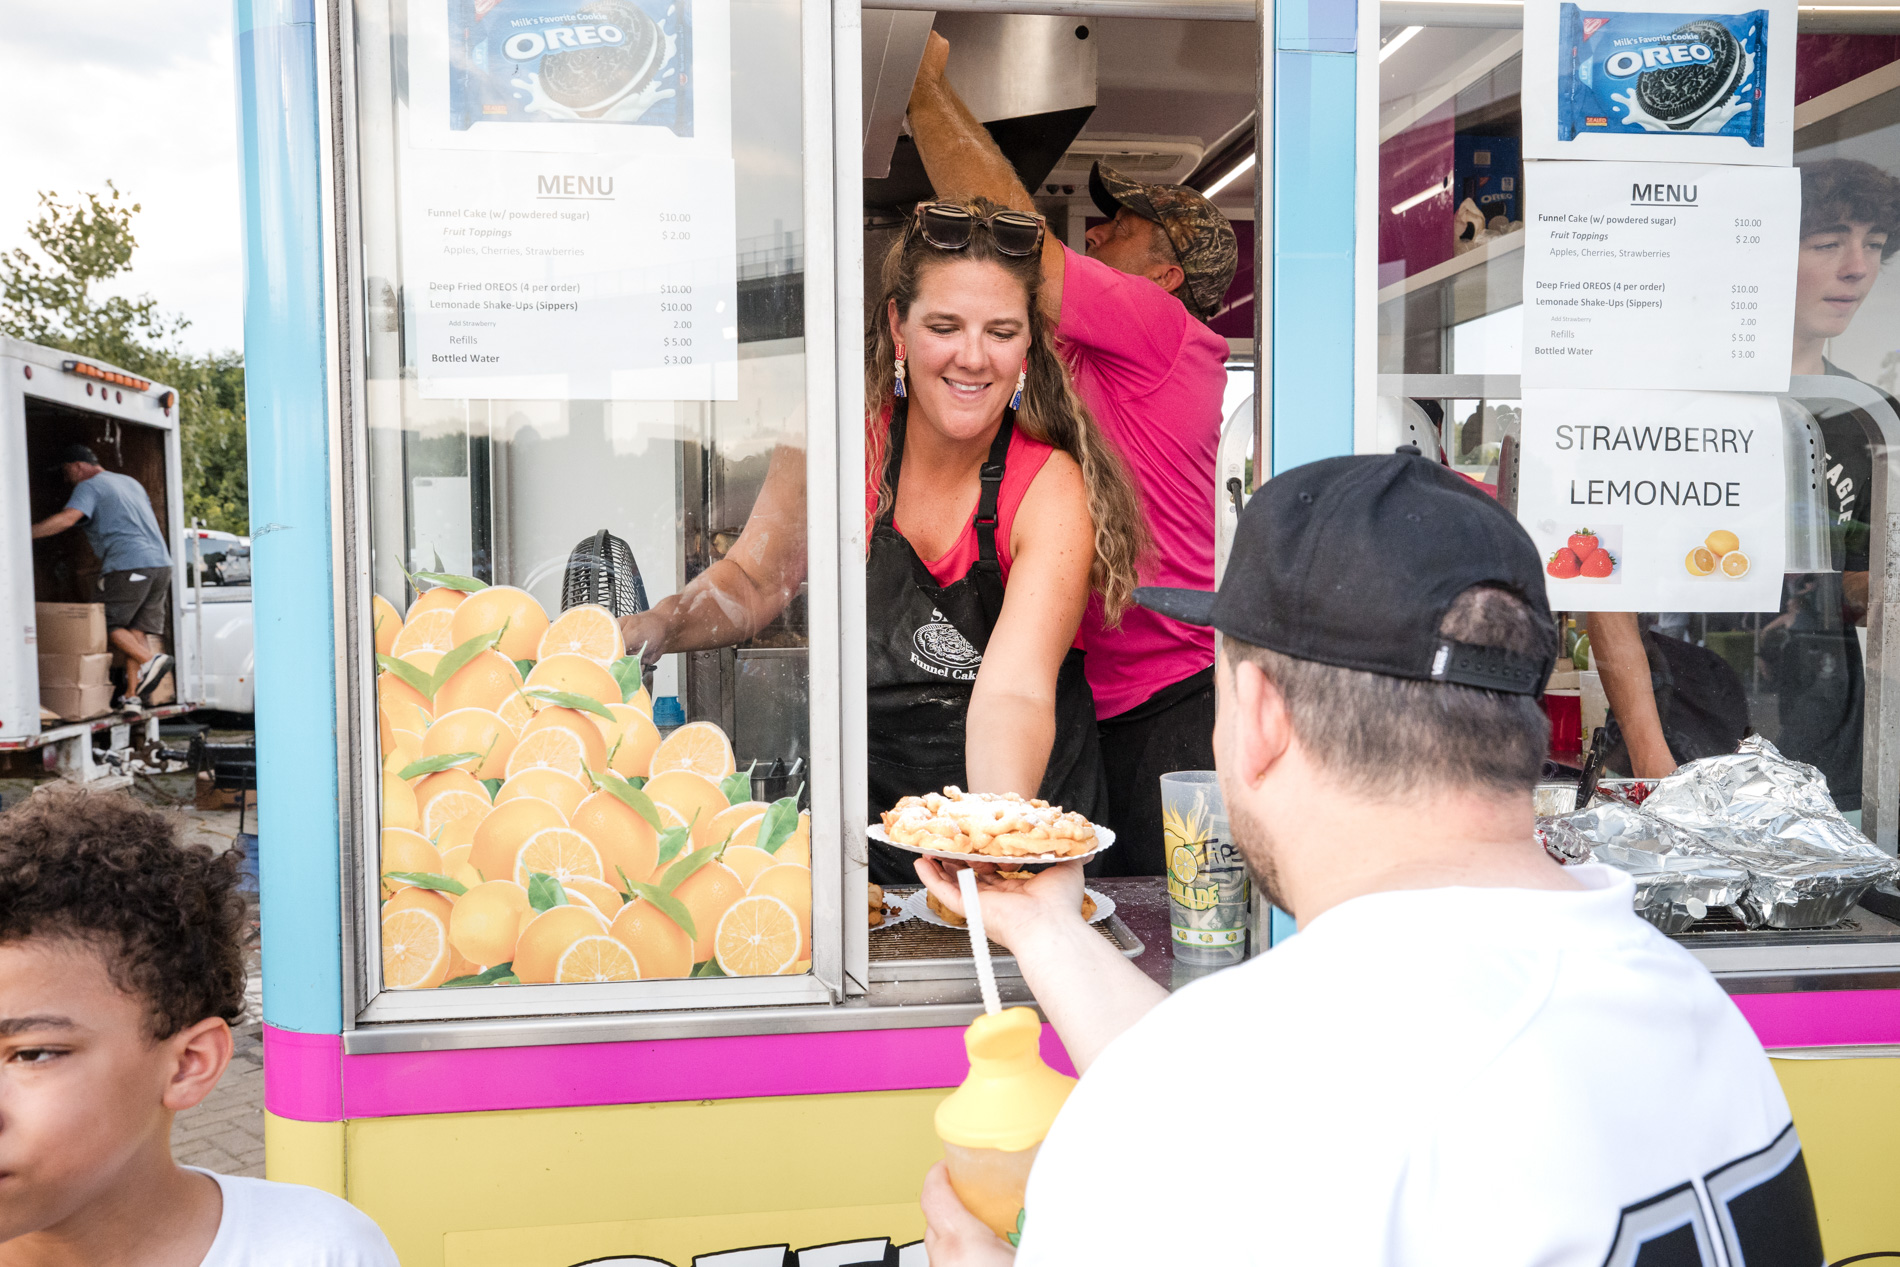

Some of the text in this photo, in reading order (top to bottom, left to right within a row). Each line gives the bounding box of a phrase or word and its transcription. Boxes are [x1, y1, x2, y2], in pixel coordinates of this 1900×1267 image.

[510, 11, 607, 28] Milk's Favorite Cookie
[503, 25, 623, 61] OREO
[1613, 33, 1699, 47] Milk's Favorite Cookie
[1606, 44, 1711, 78] OREO
[537, 174, 614, 196] MENU
[1481, 192, 1513, 204] OREO
[1631, 183, 1698, 204] MENU
[428, 208, 591, 223] Funnel Cake (w/ powdered sugar)
[659, 212, 691, 223] $10.00
[1538, 213, 1677, 227] Funnel Cake (w/ powdered sugar)
[1734, 217, 1762, 229] $10.00
[443, 227, 513, 240] Fruit Toppings
[670, 230, 691, 241] 2.00
[1550, 230, 1609, 243] Fruit Toppings
[1743, 235, 1761, 245] 2.00
[443, 245, 585, 258] Apples, Cherries, Strawberries
[1550, 247, 1671, 260] Apples, Cherries, Strawberries
[429, 282, 581, 295] Deep Fried OREOS (4 per order)
[660, 284, 692, 295] $10.00
[1536, 281, 1666, 294] Deep Fried OREOS (4 per order)
[1731, 284, 1759, 295] $10.00
[430, 299, 579, 313] Lemonade Shake-Ups (Sippers)
[660, 302, 692, 313] $10.00
[1536, 298, 1663, 310] Lemonade Shake-Ups (Sippers)
[1730, 300, 1758, 311] $10.00
[449, 319, 497, 329] Add Strawberry
[673, 320, 693, 330] 2.00
[1550, 315, 1592, 325] Add Strawberry
[1740, 317, 1757, 327] 2.00
[449, 334, 478, 345] Refills
[1550, 330, 1575, 340] Refills
[1738, 333, 1756, 343] 5.00
[672, 337, 693, 347] 5.00
[1535, 346, 1594, 357] Bottled Water
[1738, 350, 1755, 360] 3.00
[431, 353, 500, 364] Bottled Water
[672, 355, 693, 366] 3.00
[1555, 424, 1754, 454] STRAWBERRY
[1569, 479, 1741, 507] LEMONADE
[1825, 452, 1855, 526] AGLE
[910, 651, 978, 680] Funnel Cak
